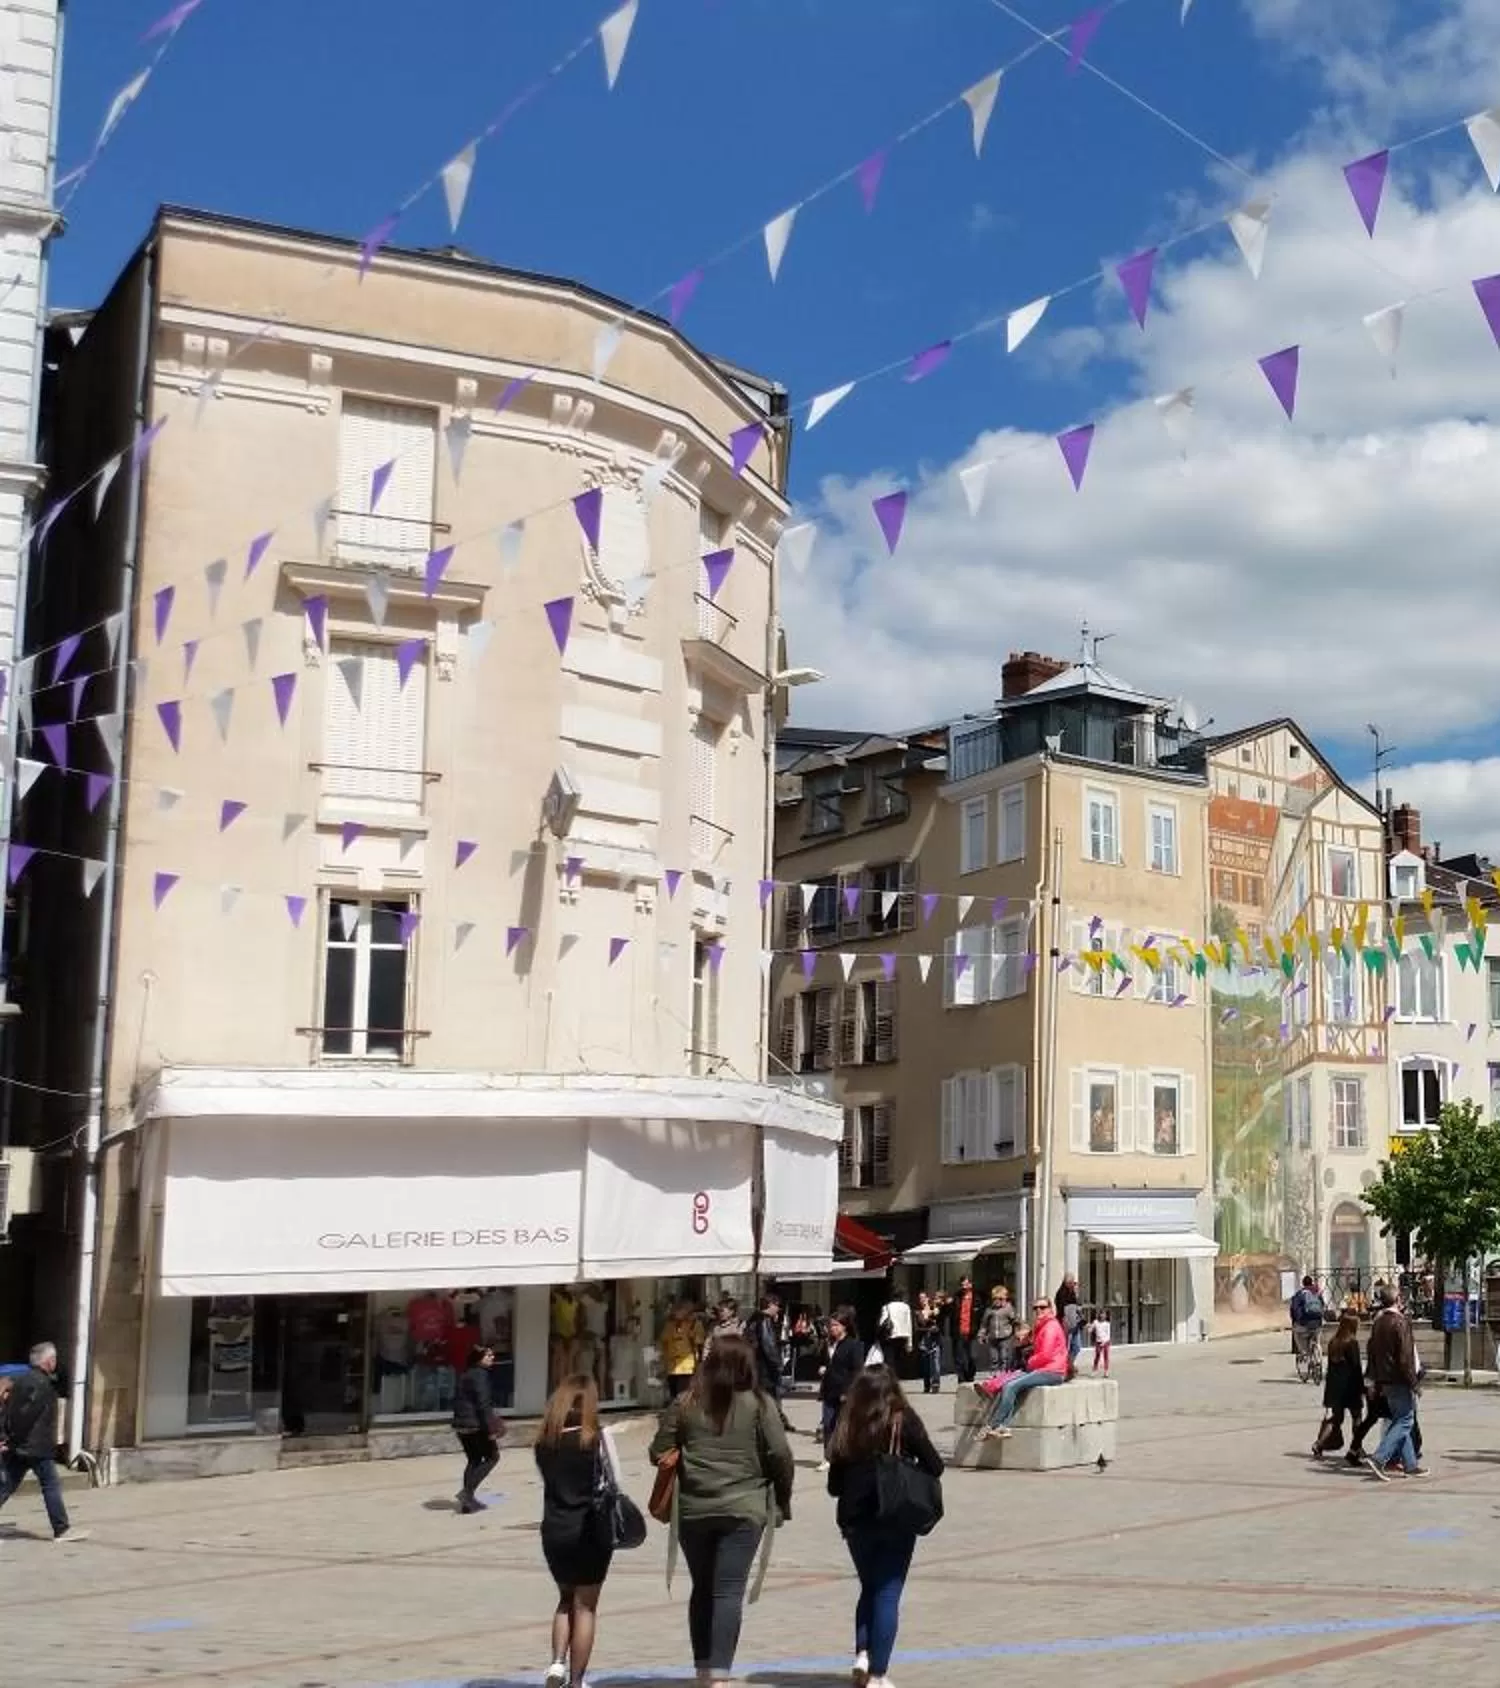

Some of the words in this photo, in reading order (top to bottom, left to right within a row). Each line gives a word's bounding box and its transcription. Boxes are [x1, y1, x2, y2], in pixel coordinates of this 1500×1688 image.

[318, 1231, 446, 1250] GALERIE
[452, 1228, 507, 1248] DES
[513, 1227, 570, 1245] BAS
